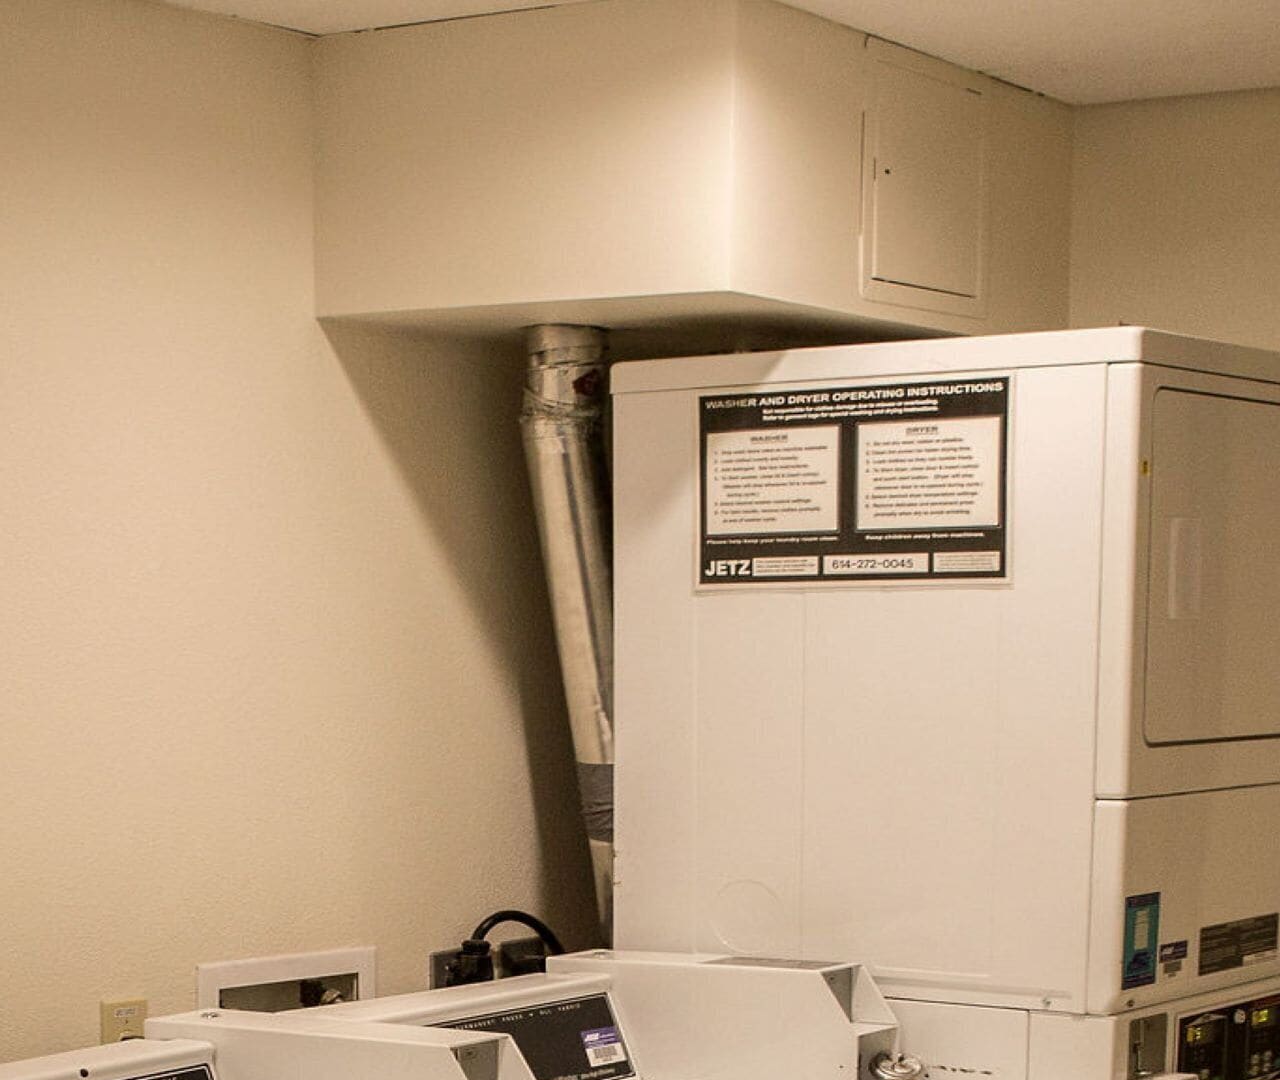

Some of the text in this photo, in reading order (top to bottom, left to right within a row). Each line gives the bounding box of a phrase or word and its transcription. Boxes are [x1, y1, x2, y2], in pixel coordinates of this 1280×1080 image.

[705, 382, 1004, 410] WASHER AND DRYER OPERATING INSTRUCTIONS
[705, 559, 751, 576] JETZ
